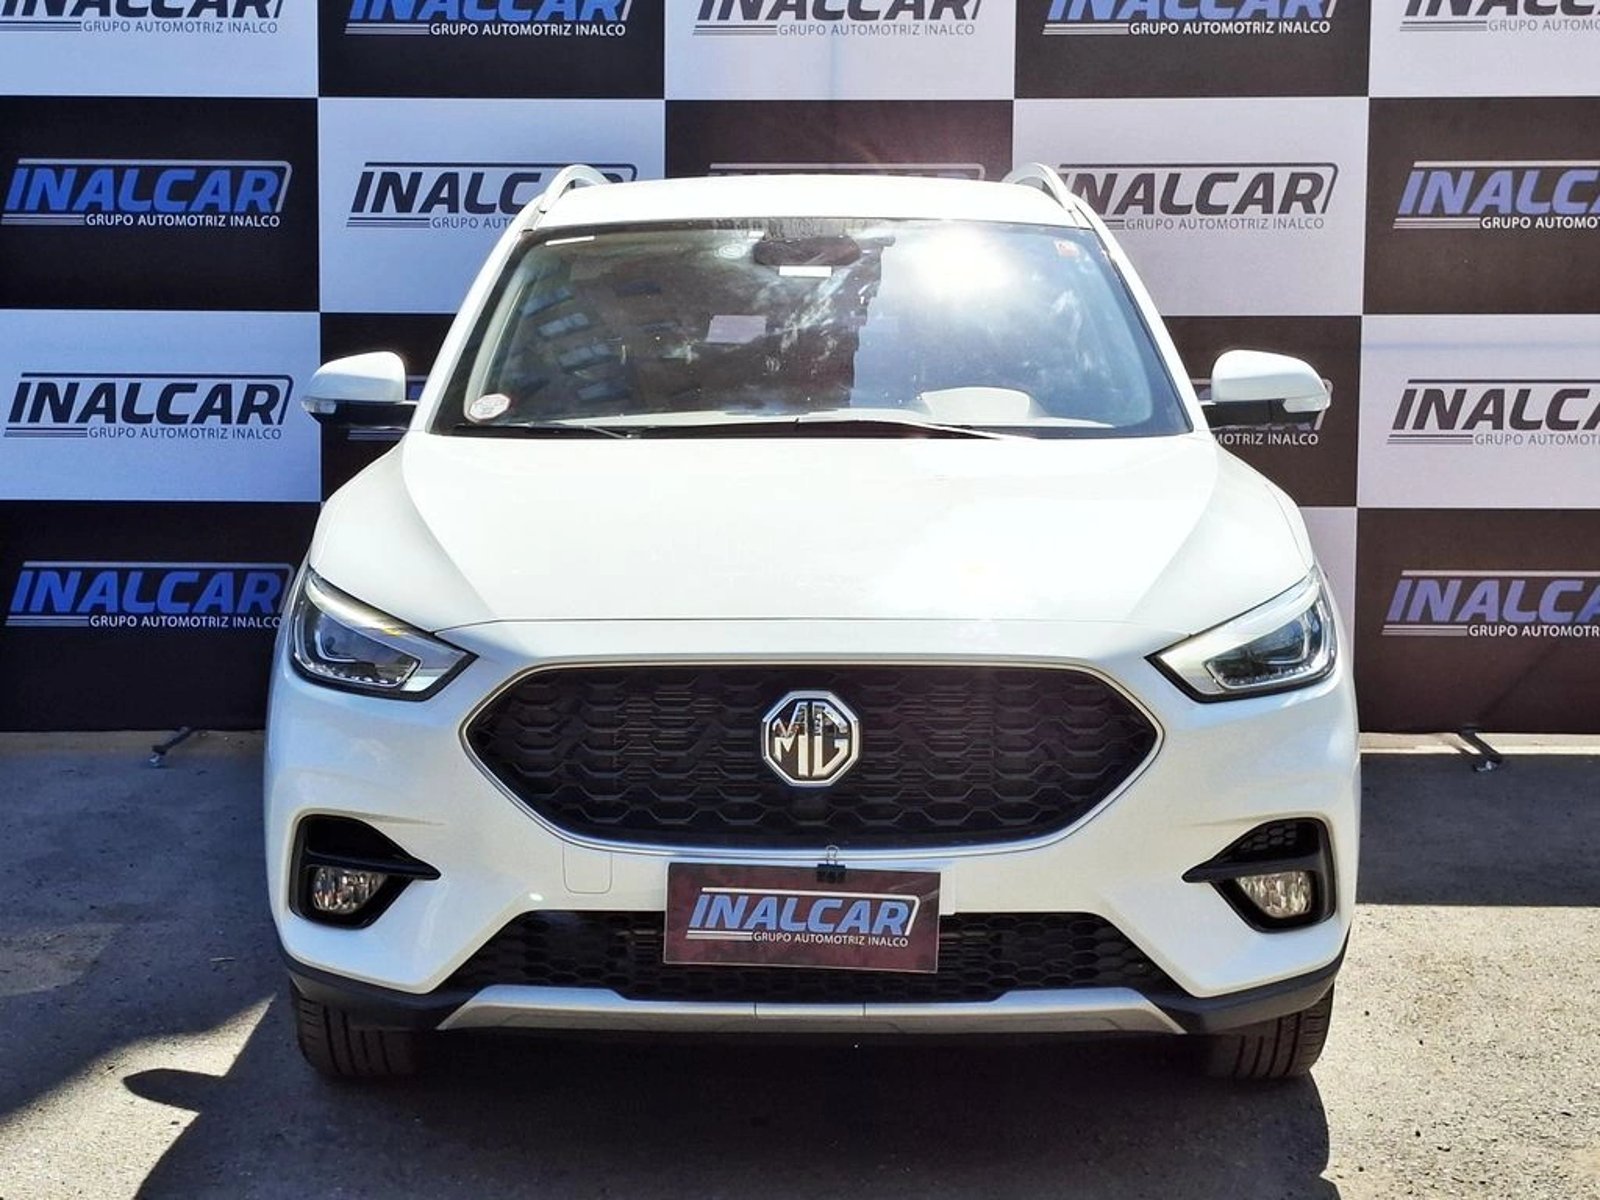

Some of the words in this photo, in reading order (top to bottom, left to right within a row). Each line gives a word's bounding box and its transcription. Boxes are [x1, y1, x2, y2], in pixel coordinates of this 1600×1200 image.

[84, 21, 130, 33] GRUPO
[136, 21, 223, 33] AUTOMOTRIZ
[228, 21, 278, 33] INALCO
[431, 23, 478, 36] GRUPO
[483, 23, 571, 36] AUTOMOTRIZ
[576, 23, 626, 36] INALCO
[779, 24, 826, 36] GRUPO
[831, 24, 920, 36] AUTOMOTRIZ
[925, 24, 975, 36] INALCO
[1130, 22, 1179, 35] GRUPO
[1183, 21, 1274, 35] AUTOMOTRIZ
[1279, 20, 1331, 34] INALCO
[1488, 19, 1537, 31] GRUPO
[4, 168, 279, 212] INALCAR
[1397, 169, 1600, 215] INALC
[86, 214, 134, 226] GRUPO
[137, 214, 226, 227] AUTOMOTRIZ
[230, 215, 280, 228] INALCO
[432, 217, 478, 229] GRUPO
[1125, 218, 1174, 230] GRUPO
[1179, 217, 1269, 230] AUTOMOTRIZ
[1273, 217, 1325, 230] INALCO
[1481, 216, 1531, 229] GRUPO
[7, 382, 281, 425] INALCAR
[89, 428, 136, 440] GRUPO
[140, 428, 228, 440] AUTOMOTRIZ
[232, 428, 282, 440] INALCO
[1268, 433, 1319, 445] INALCO
[1475, 434, 1524, 445] GRUPO
[10, 571, 281, 614] INALCAR
[90, 616, 137, 628] GRUPO
[141, 616, 229, 628] AUTOMOTRIZ
[1469, 625, 1517, 637] GRUPO
[772, 702, 849, 776] MG
[688, 894, 911, 936] INALCAR
[753, 932, 791, 944] GRUPO
[794, 933, 865, 945] AUTOMOTRIZ
[868, 936, 909, 947] INALCO
